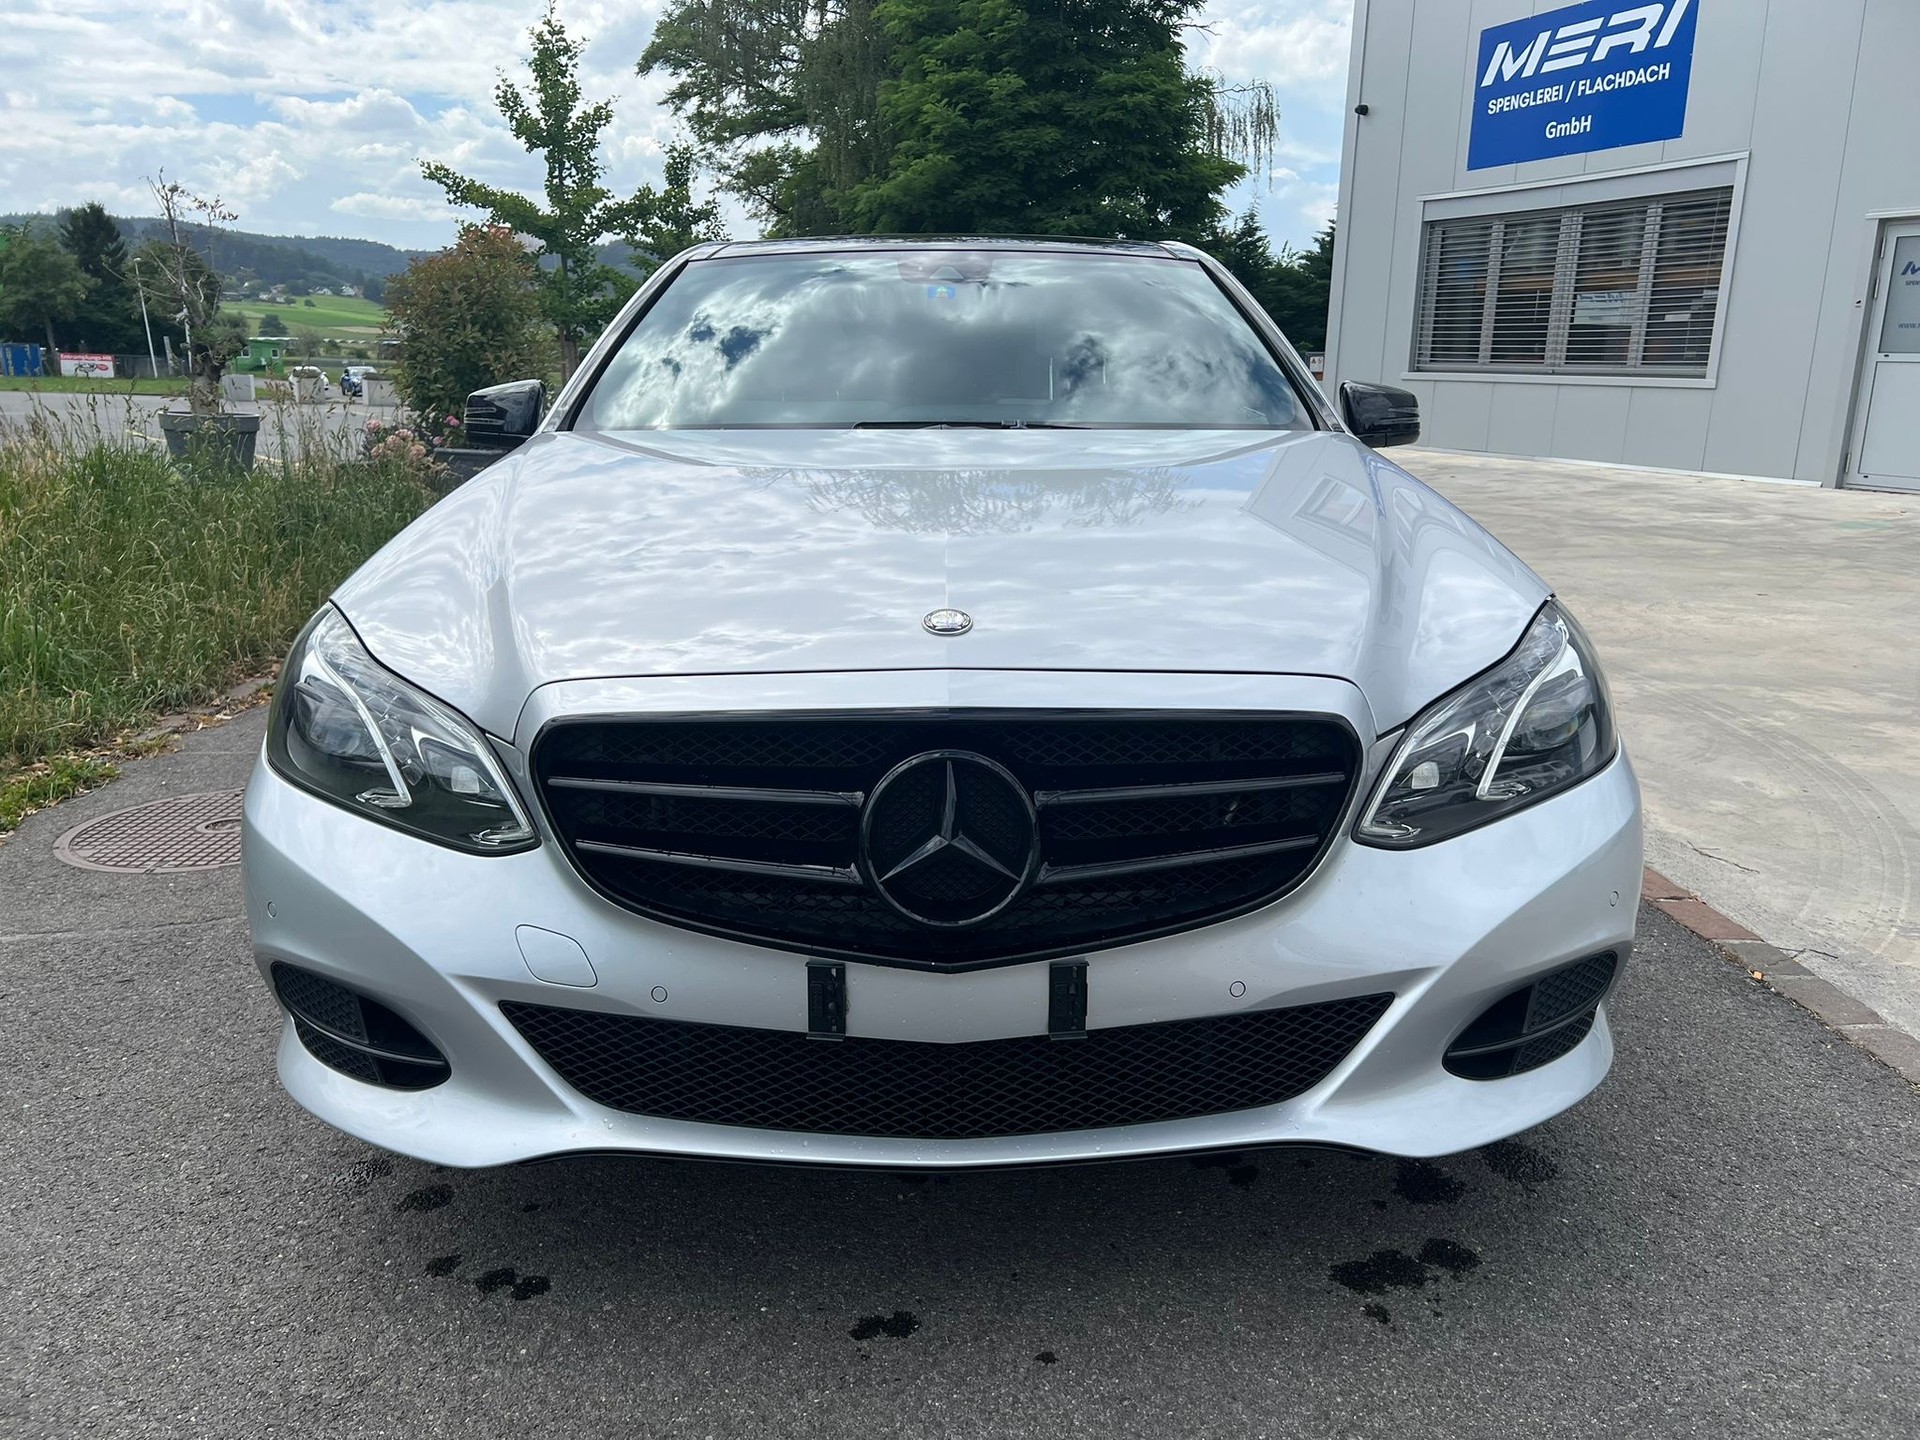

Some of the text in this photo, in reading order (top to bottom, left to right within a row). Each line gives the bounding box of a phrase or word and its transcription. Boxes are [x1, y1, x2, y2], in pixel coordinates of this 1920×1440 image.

[1480, 0, 1689, 87] MERI
[1487, 85, 1563, 115] SPENGLEREI
[1577, 62, 1671, 97] FLACHDACH
[1545, 115, 1592, 139] GmbH
